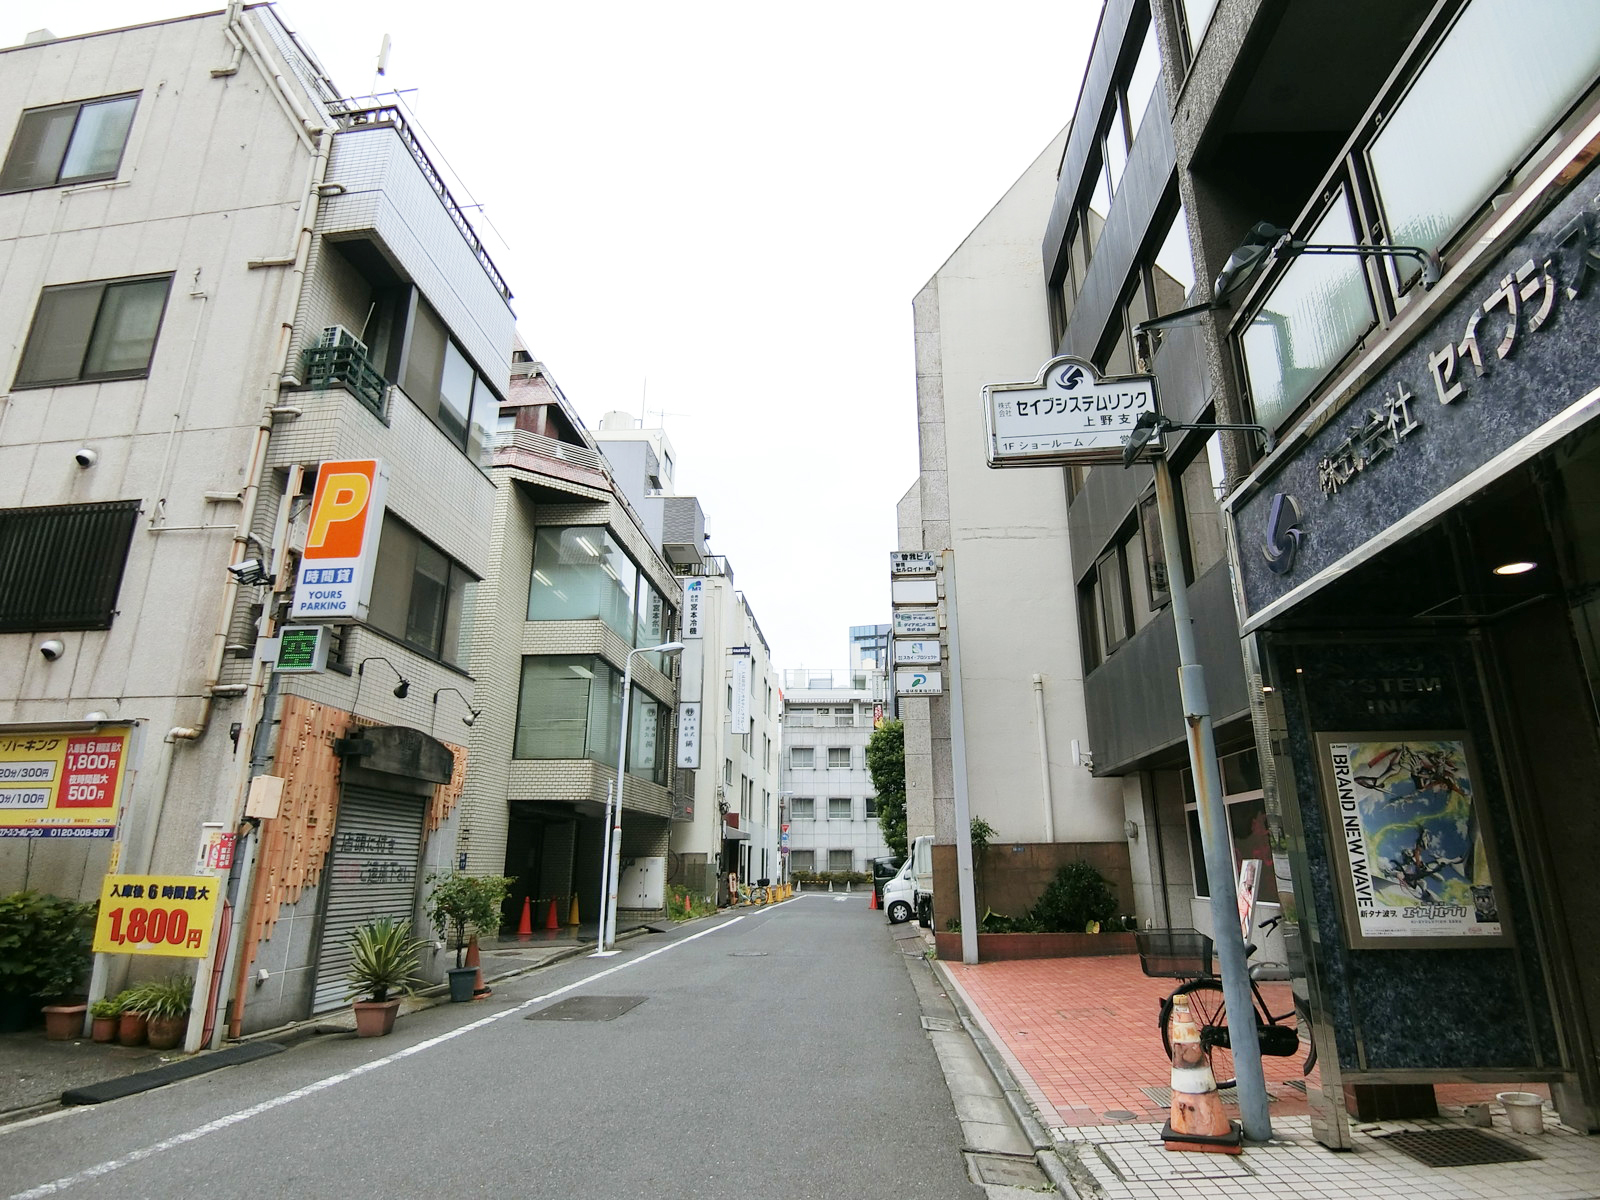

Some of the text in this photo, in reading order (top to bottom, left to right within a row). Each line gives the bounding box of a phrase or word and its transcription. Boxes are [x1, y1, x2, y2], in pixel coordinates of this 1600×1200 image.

[1428, 193, 1600, 406] セイブシス
[1016, 391, 1146, 416] セイブシステムリンク
[305, 569, 351, 584] 時間貸
[309, 591, 342, 600] YOURS
[300, 601, 346, 611] PARKING
[68, 755, 116, 771] 1,800円
[68, 786, 104, 800] 500円
[1333, 754, 1374, 908] BRAND NEW WAVE
[108, 908, 203, 949] 1,800円
